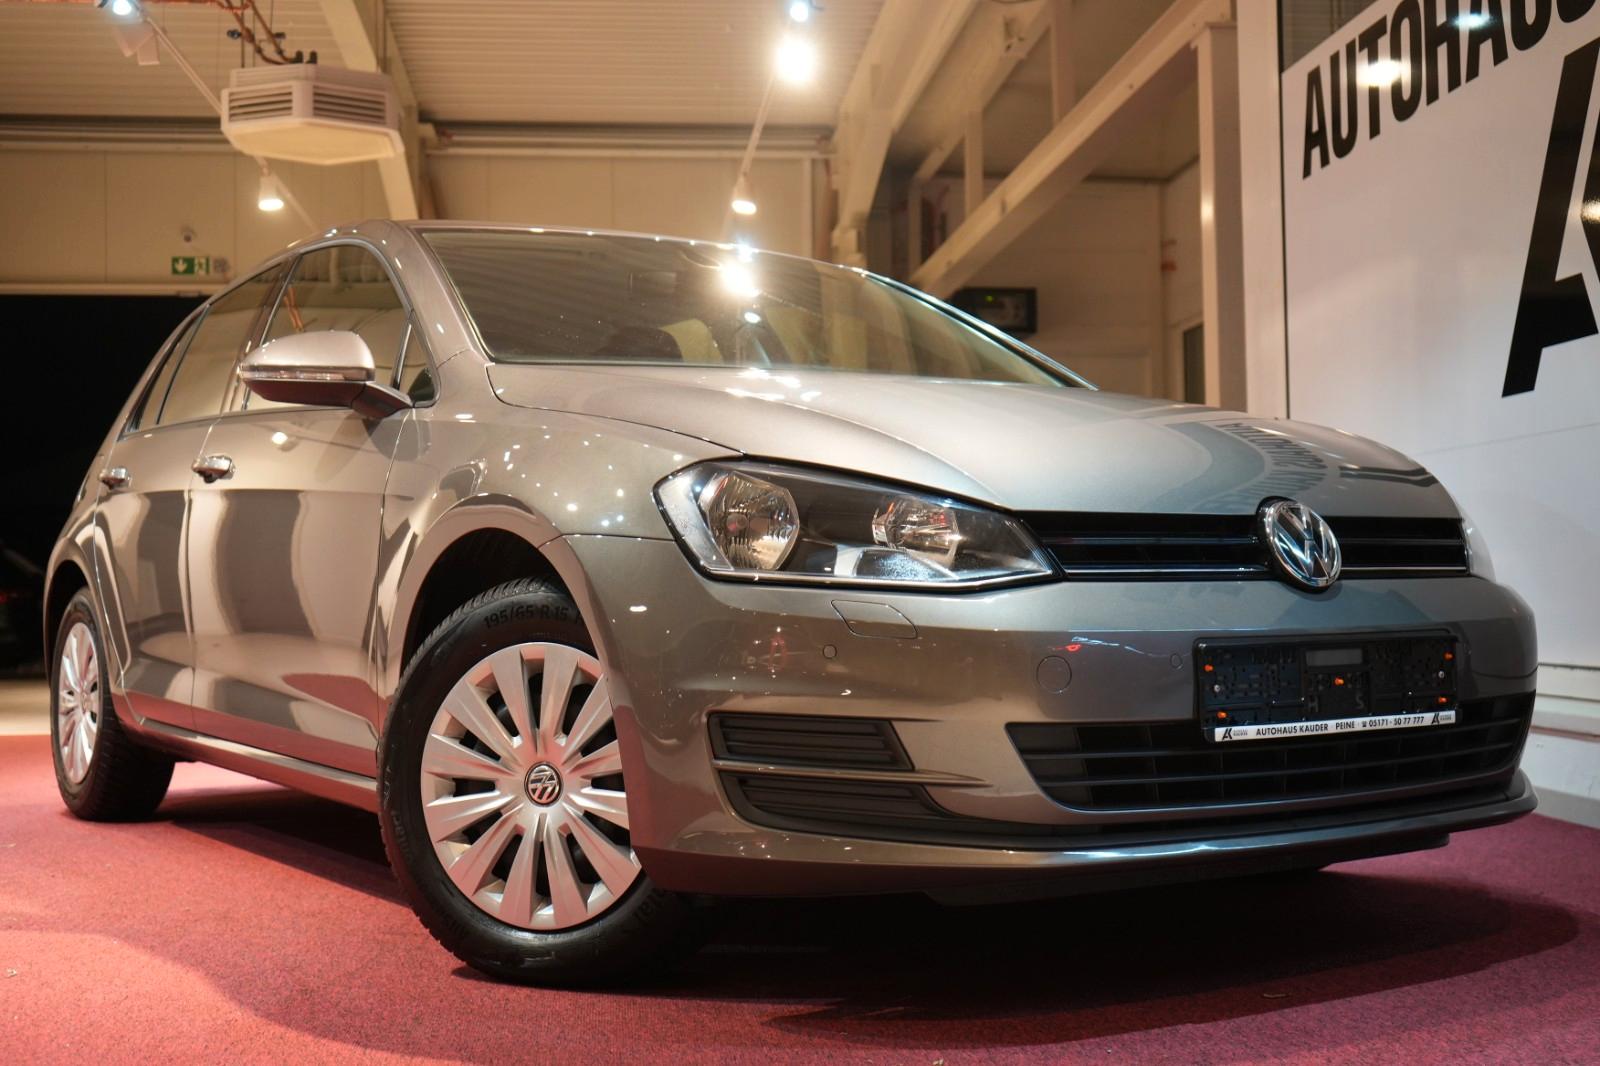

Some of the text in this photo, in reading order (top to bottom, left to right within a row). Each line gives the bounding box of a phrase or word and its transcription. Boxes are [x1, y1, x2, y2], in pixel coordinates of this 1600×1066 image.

[1256, 725, 1298, 736] AUTOHAUS
[1299, 723, 1329, 733] KAUDER
[1335, 720, 1355, 730] PEINE
[1369, 718, 1389, 728] 05171
[1394, 717, 1402, 726] 50
[1403, 716, 1411, 725] 77
[1413, 715, 1425, 724] 777
